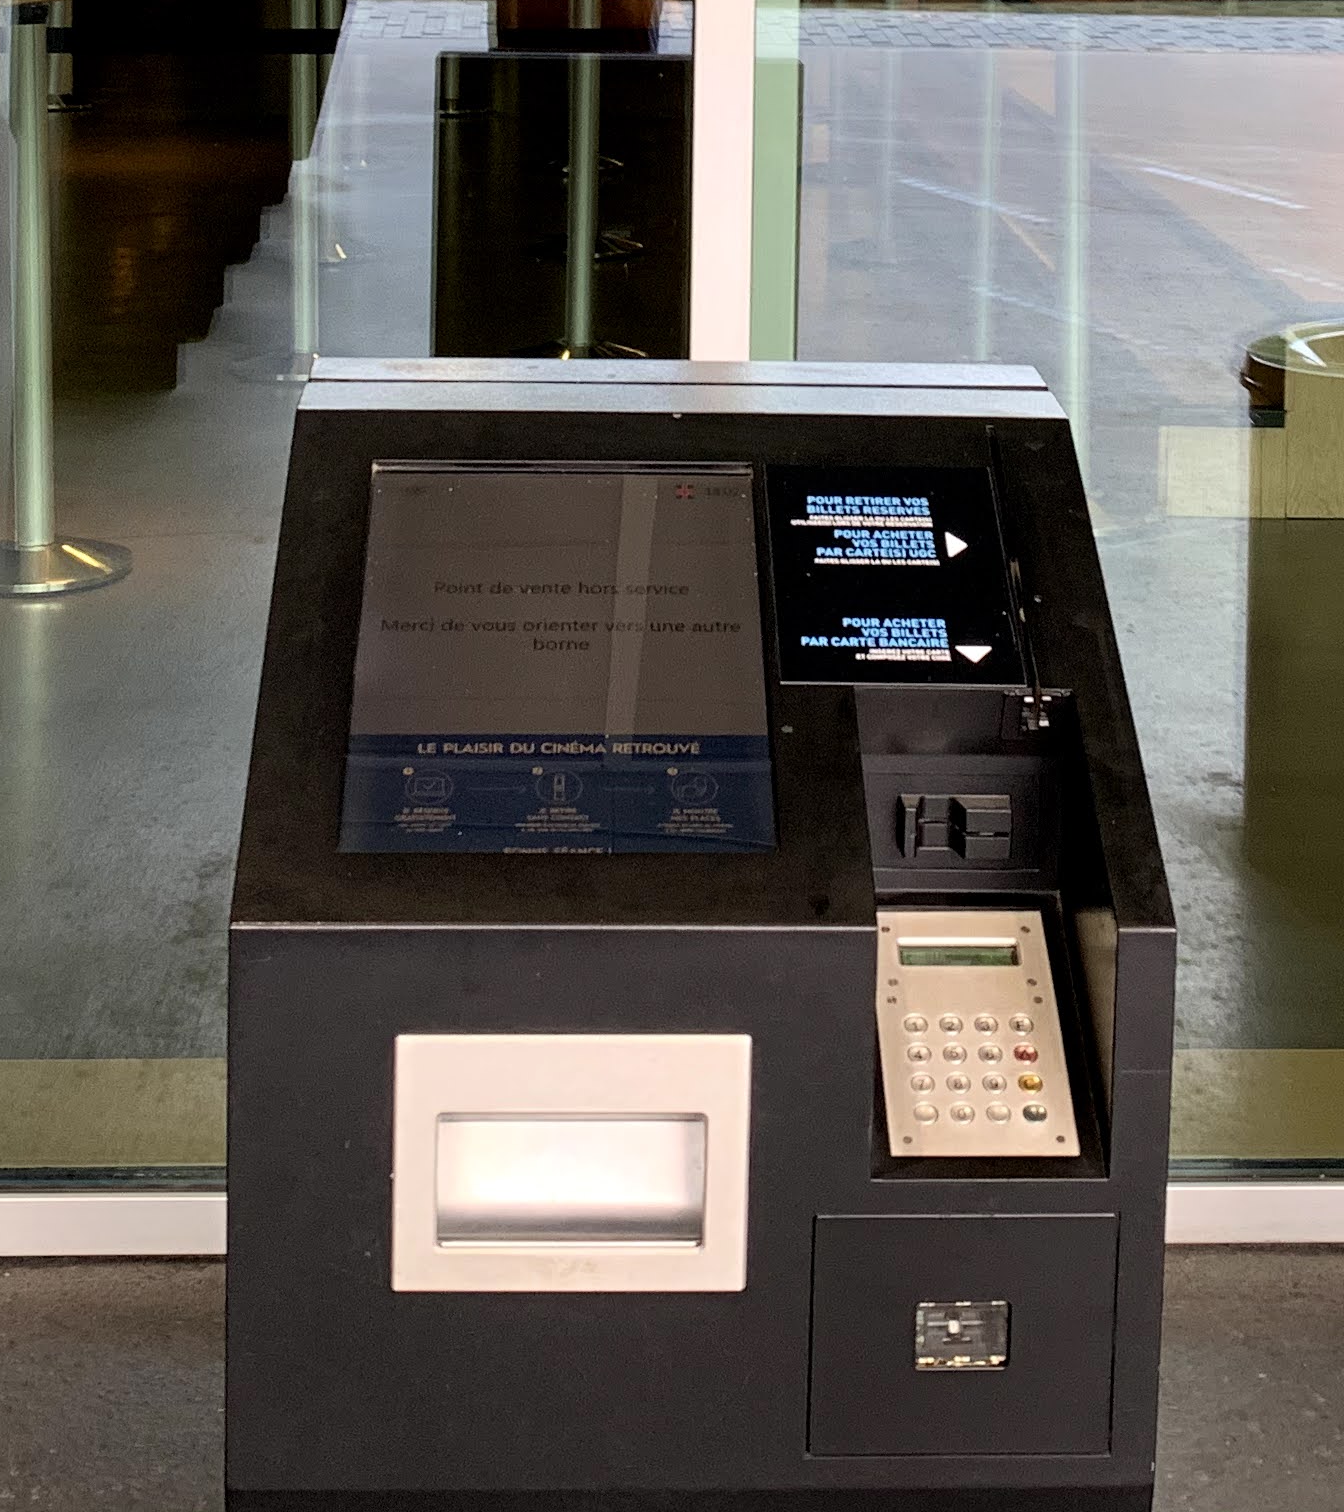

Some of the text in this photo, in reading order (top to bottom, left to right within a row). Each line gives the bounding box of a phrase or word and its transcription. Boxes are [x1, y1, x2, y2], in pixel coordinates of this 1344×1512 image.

[807, 496, 928, 507] POUR RETIRER VOS
[807, 505, 860, 515] BILLETS
[834, 530, 934, 540] POUR ACHETER
[852, 539, 935, 549] VOS BILLETS
[817, 547, 842, 557] PAR
[909, 548, 937, 557] UGC
[434, 582, 689, 595] Point de vente hors service
[381, 618, 741, 633] Merci de vous orienter vers une autre
[843, 618, 946, 628] POUR ACHETER
[861, 627, 947, 638] VOS BILLETS
[533, 638, 590, 651] borne
[801, 636, 949, 648] PAR CARTE BANCAIRE
[418, 743, 436, 754] LE
[443, 743, 503, 754] PLAISIR
[510, 743, 534, 754] DU
[541, 741, 606, 755] CINÉMA
